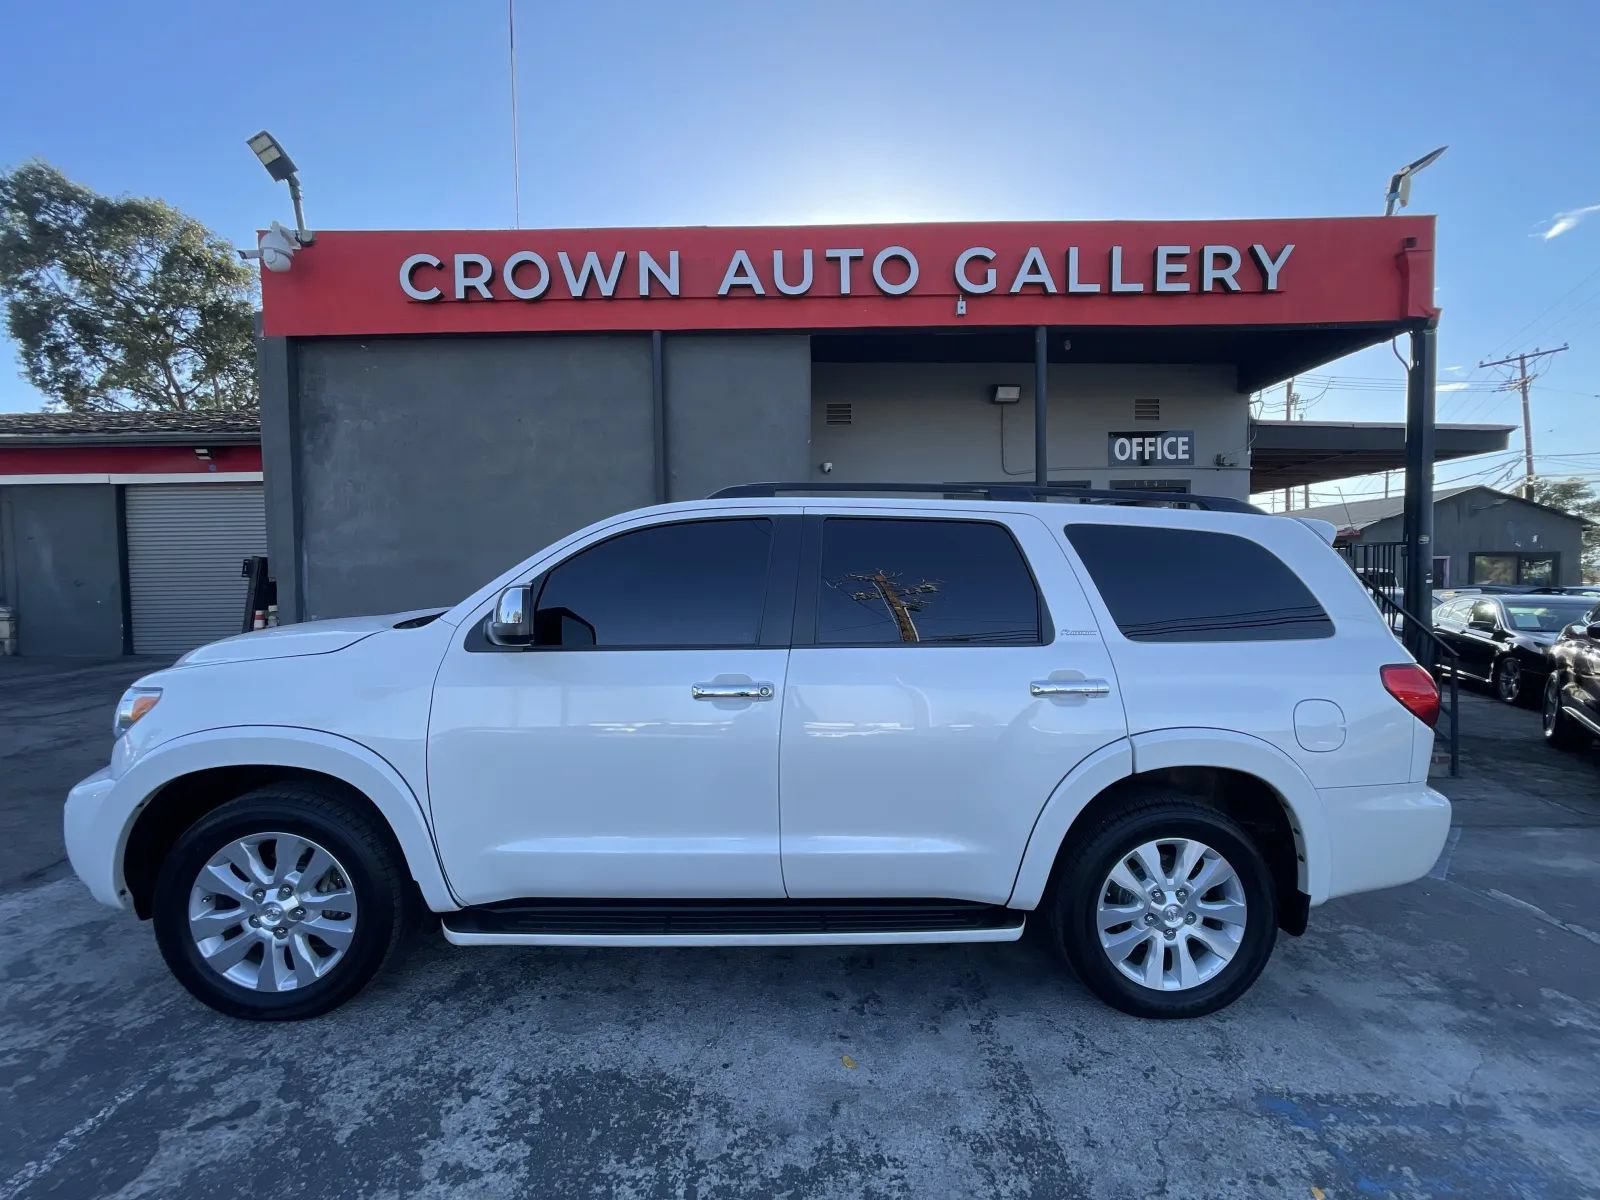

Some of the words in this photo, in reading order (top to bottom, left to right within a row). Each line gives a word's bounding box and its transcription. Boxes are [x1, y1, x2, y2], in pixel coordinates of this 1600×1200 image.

[399, 250, 681, 301] CROWN
[717, 246, 920, 297] AUTO
[954, 243, 1296, 295] GALLERY
[1114, 437, 1190, 461] OFFICE
